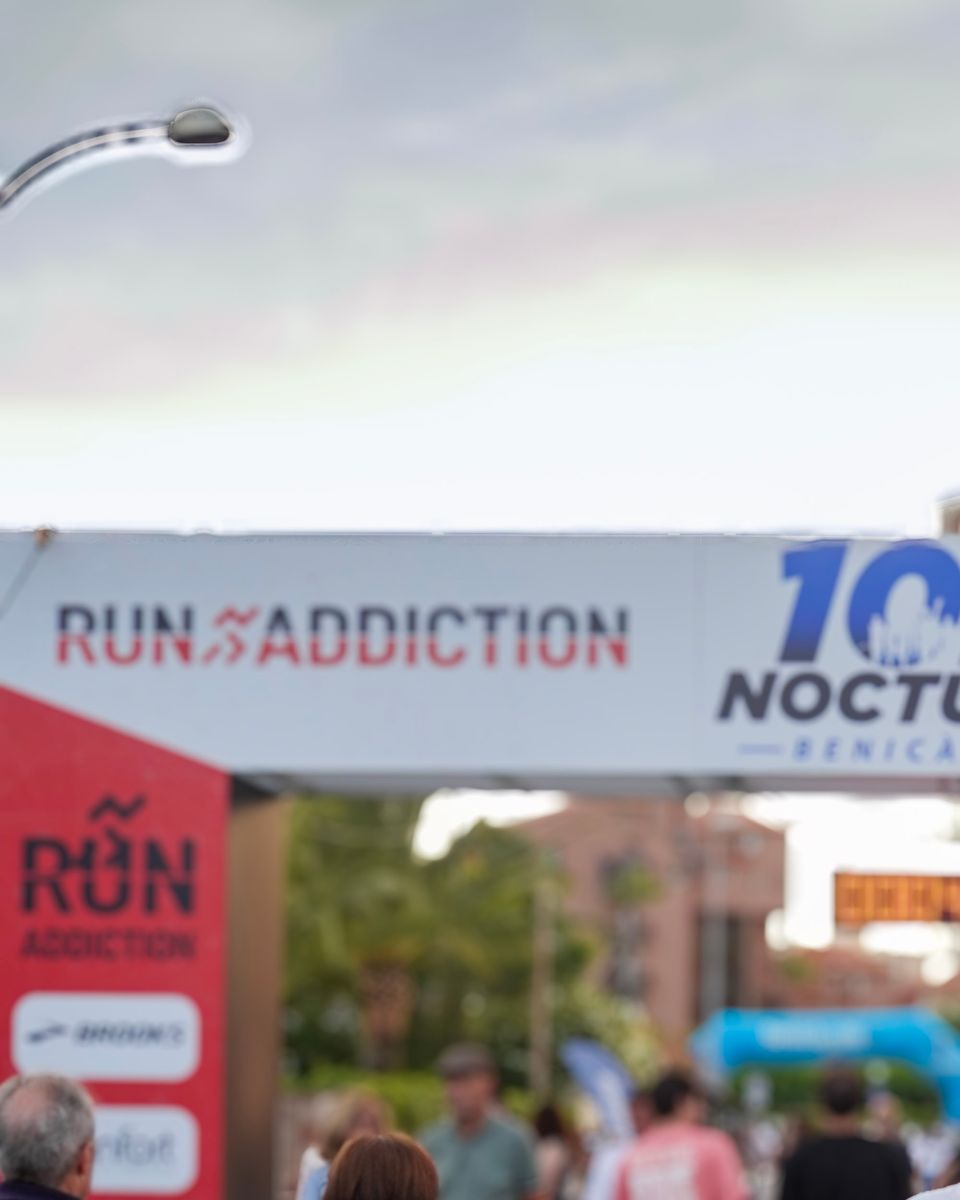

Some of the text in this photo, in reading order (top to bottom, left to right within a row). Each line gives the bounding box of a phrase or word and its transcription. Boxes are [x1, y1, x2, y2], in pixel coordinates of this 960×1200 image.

[57, 604, 630, 669] RUN ADDICTION
[20, 929, 197, 961] ADDICTION
